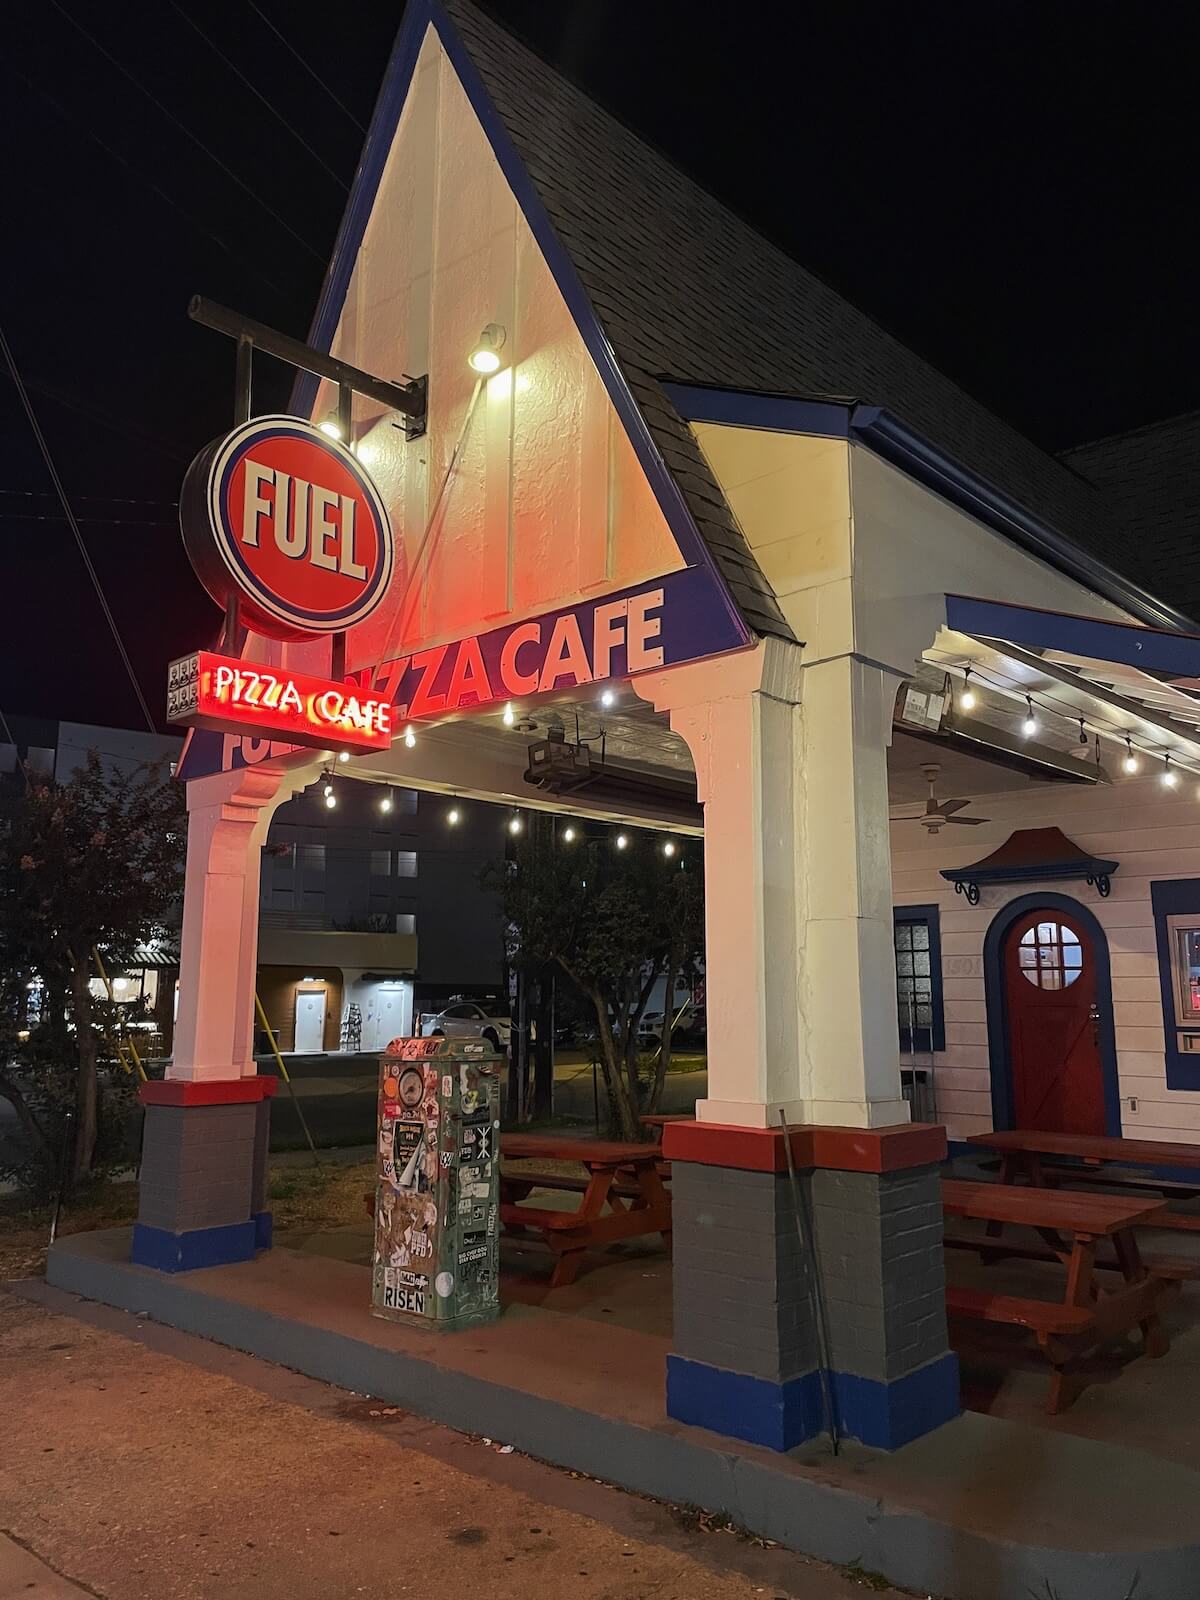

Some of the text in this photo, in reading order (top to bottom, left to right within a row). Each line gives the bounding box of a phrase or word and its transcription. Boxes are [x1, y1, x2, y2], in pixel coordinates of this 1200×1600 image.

[241, 458, 368, 582] FUEL
[500, 588, 665, 696] CAFE
[215, 665, 391, 733] PIZZA CAFE
[385, 1288, 424, 1313] RISEN
